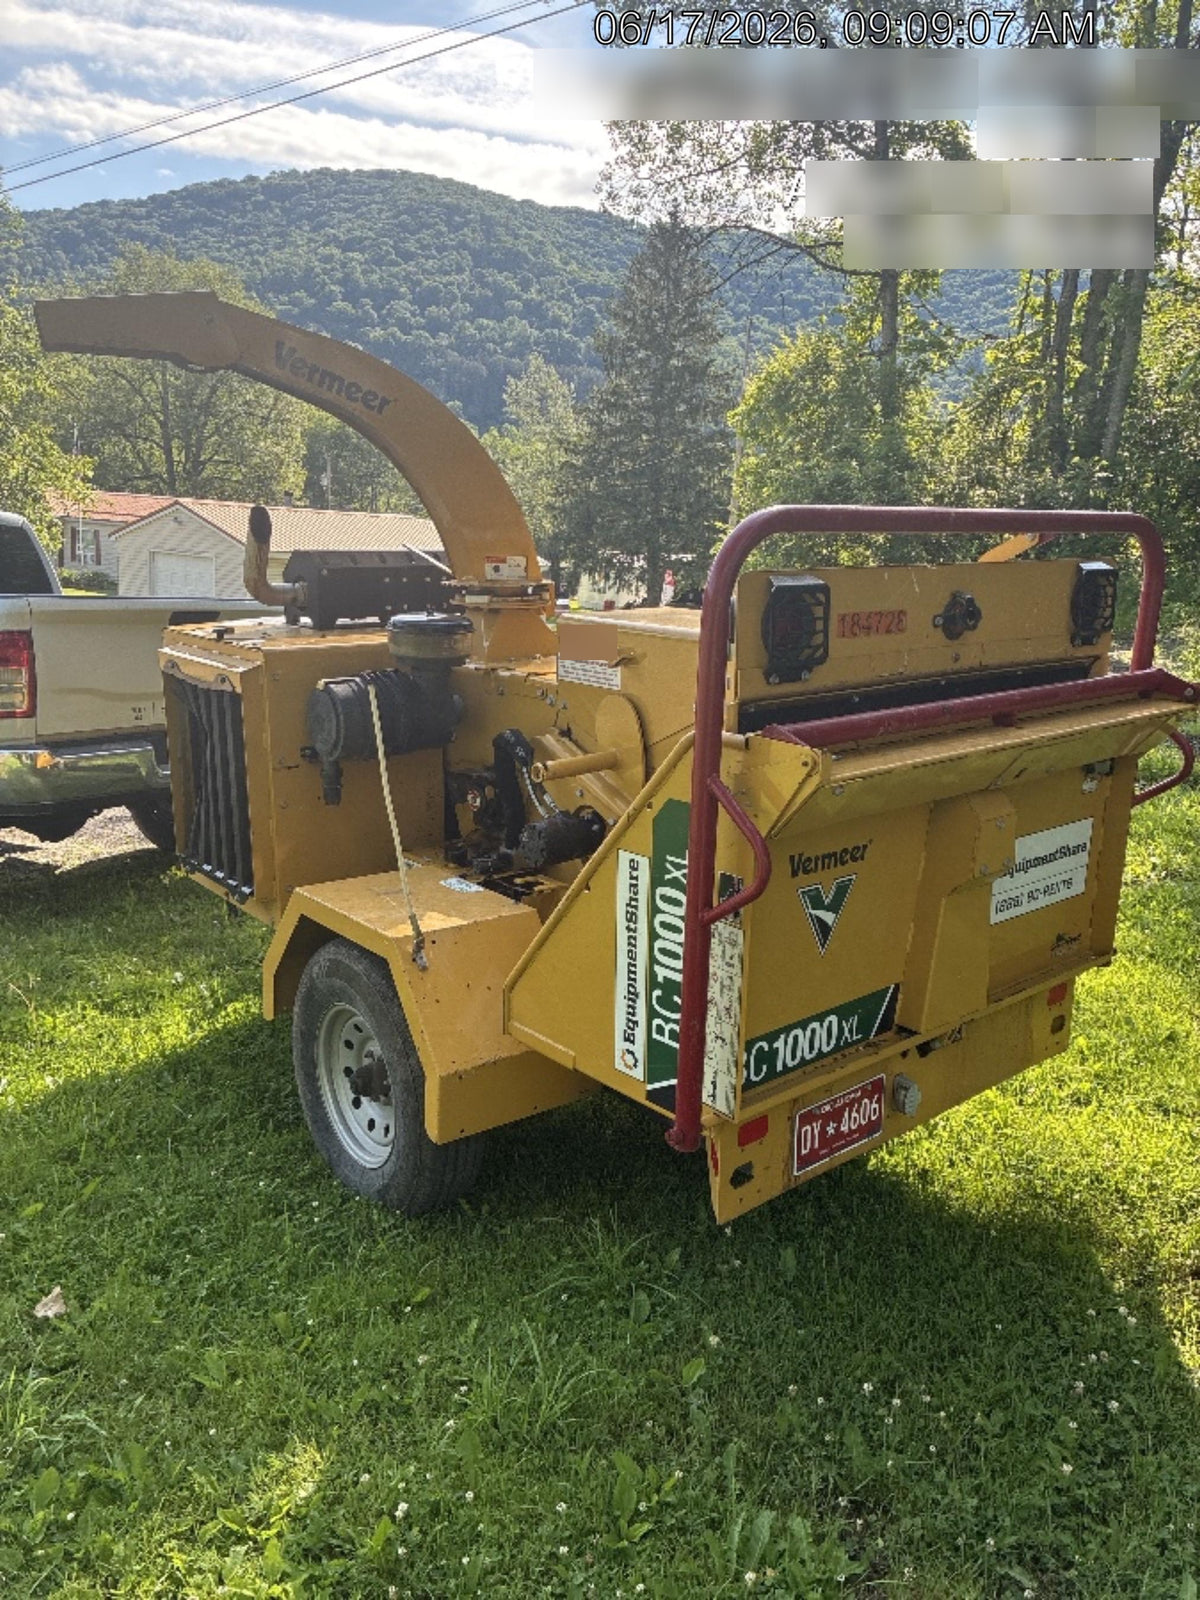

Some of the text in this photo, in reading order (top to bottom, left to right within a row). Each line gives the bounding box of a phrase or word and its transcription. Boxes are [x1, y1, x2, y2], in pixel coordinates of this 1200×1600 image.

[275, 341, 391, 414] Vermeer
[789, 840, 871, 878] Vermeer
[1002, 842, 1087, 878] quipmentShare
[623, 858, 639, 1046] EquipmentShare
[840, 1094, 880, 1133] 4606
